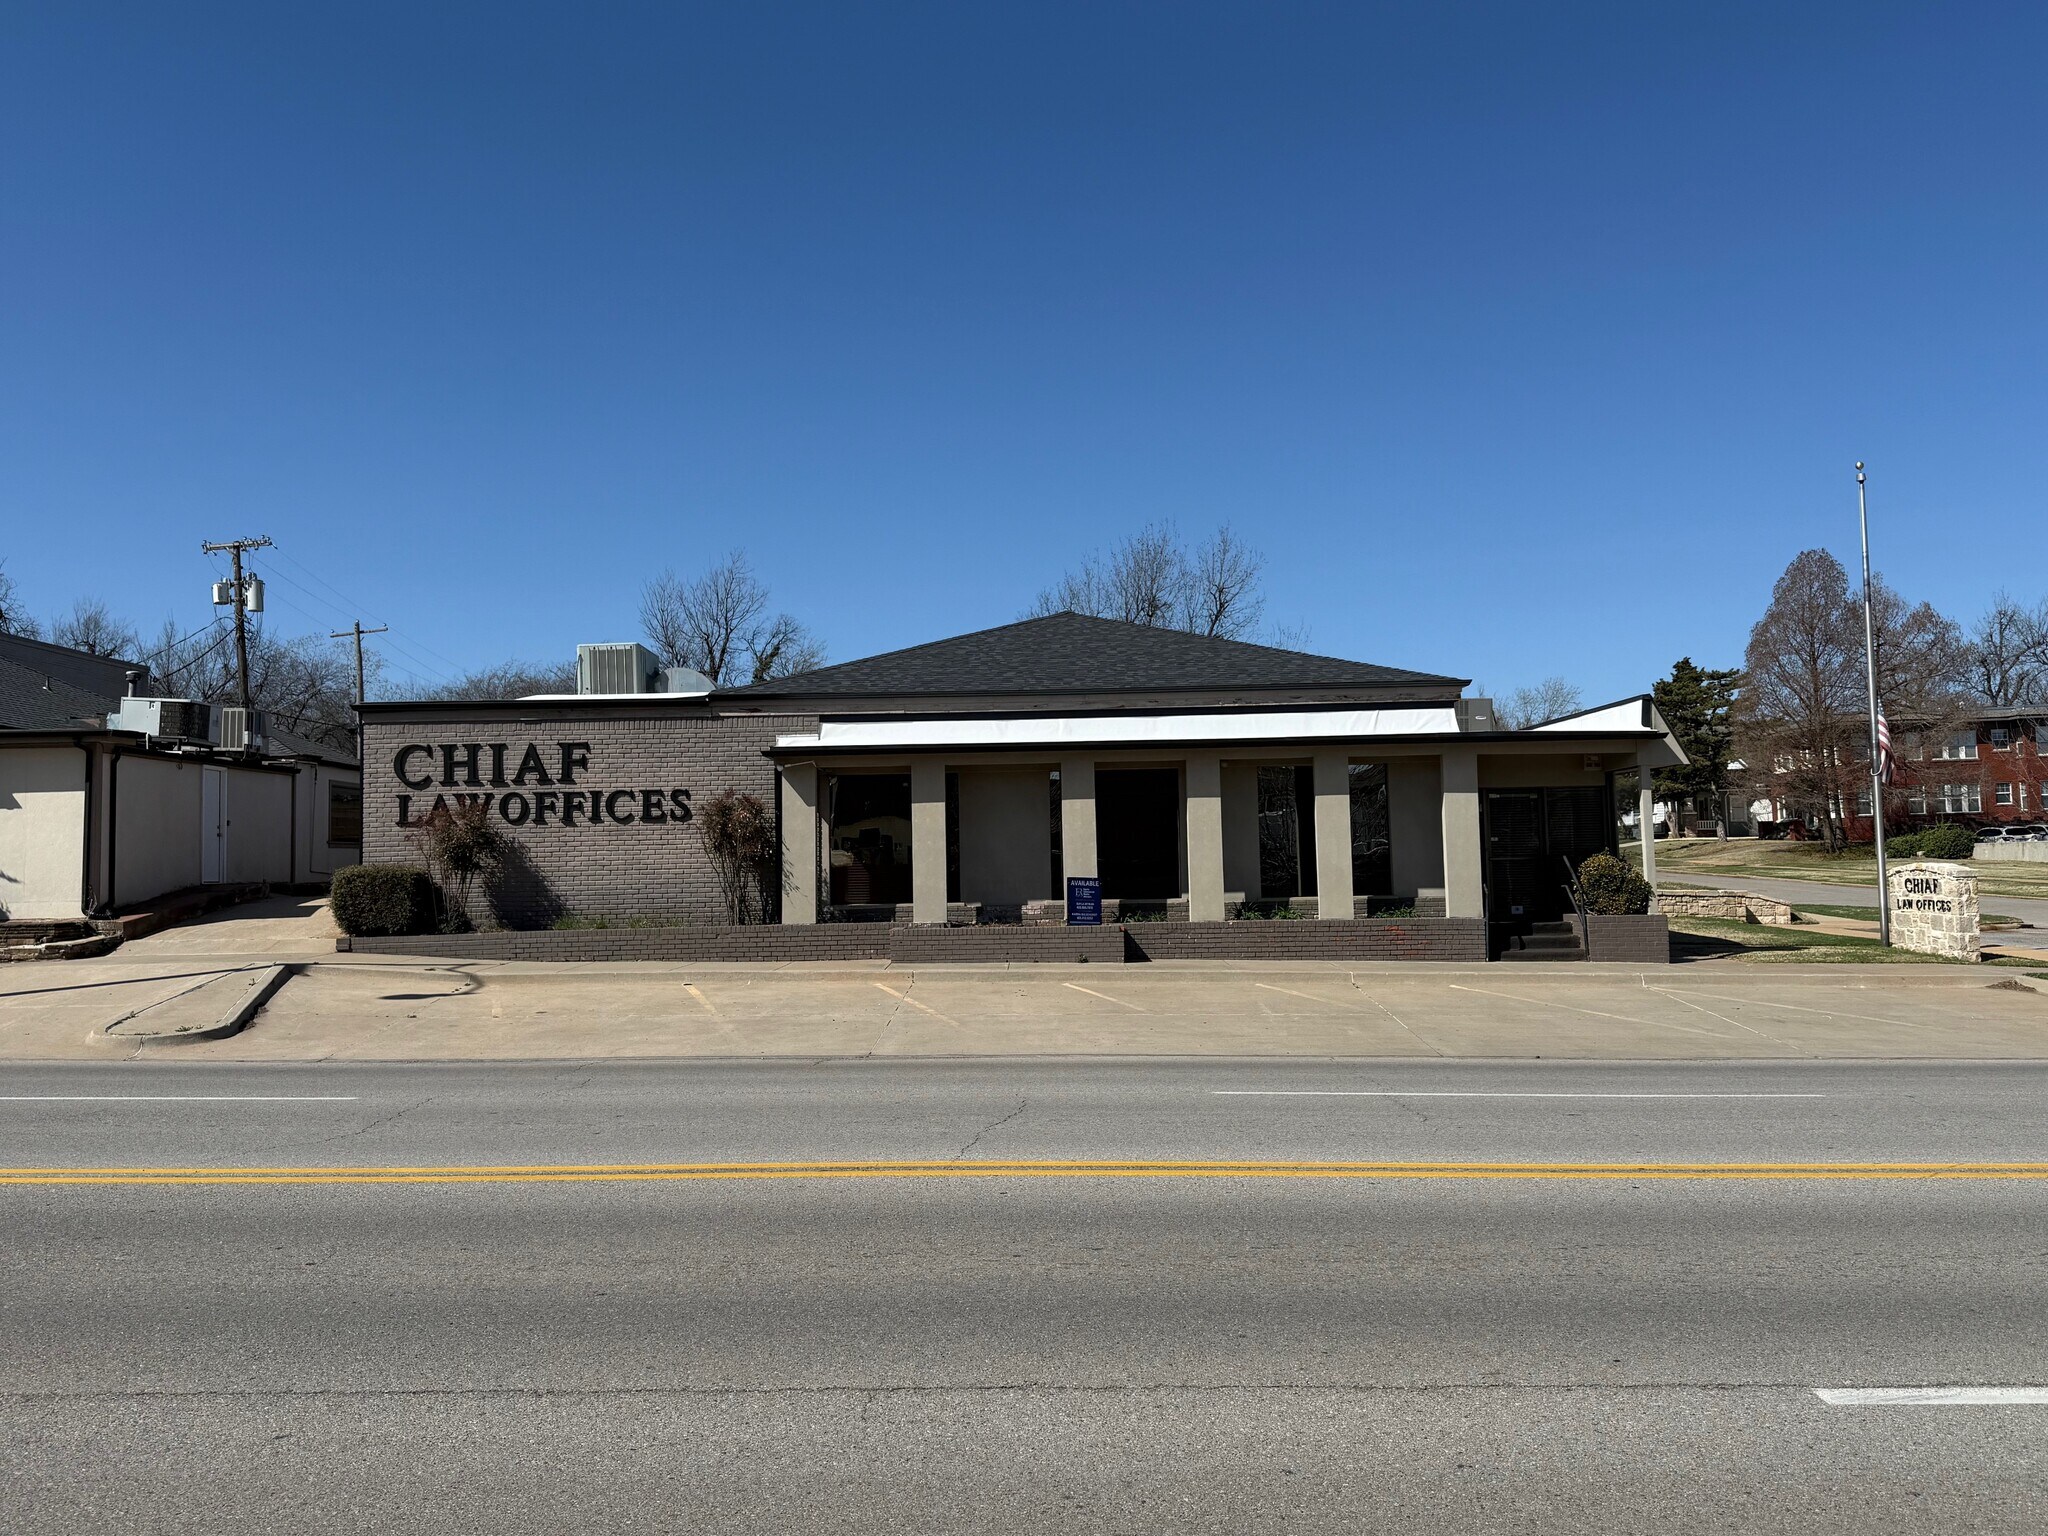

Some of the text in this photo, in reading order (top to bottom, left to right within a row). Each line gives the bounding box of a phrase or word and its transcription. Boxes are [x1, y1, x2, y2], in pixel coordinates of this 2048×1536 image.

[394, 741, 591, 790] CHIAF
[499, 788, 694, 827] OFFICES
[1904, 878, 1939, 894] CHIAF
[1897, 899, 1952, 913] LAW OFFICES
